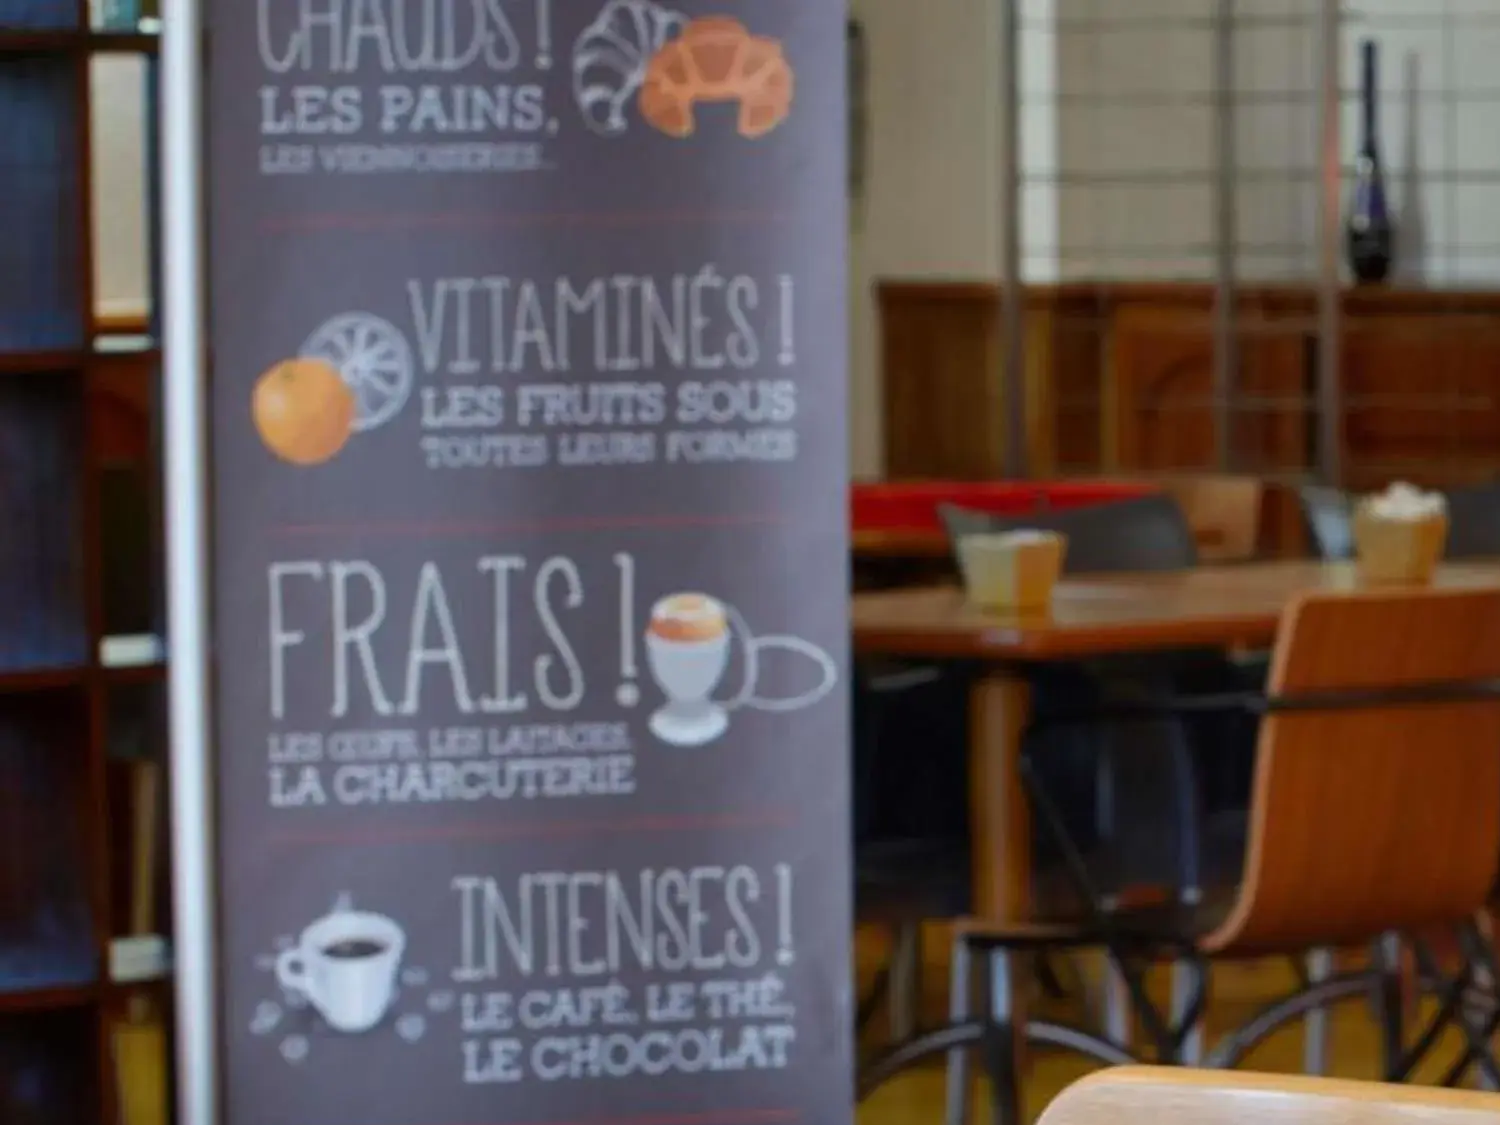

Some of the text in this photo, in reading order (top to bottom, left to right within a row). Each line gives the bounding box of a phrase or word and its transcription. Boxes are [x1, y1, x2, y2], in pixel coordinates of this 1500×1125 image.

[258, 84, 560, 138] LES PAINS,
[406, 263, 760, 373] VITAMINÉS
[419, 379, 798, 428] LES FRUITS SOUS
[266, 554, 585, 719] FRAIS
[266, 731, 323, 763] LES
[428, 726, 482, 758] LES
[268, 754, 637, 807] LA CHARCUTERIE
[450, 865, 762, 981] INTENSES
[461, 991, 513, 1032] LE
[645, 982, 696, 1022] LE
[462, 1024, 795, 1083] LE CHOCOLAT
